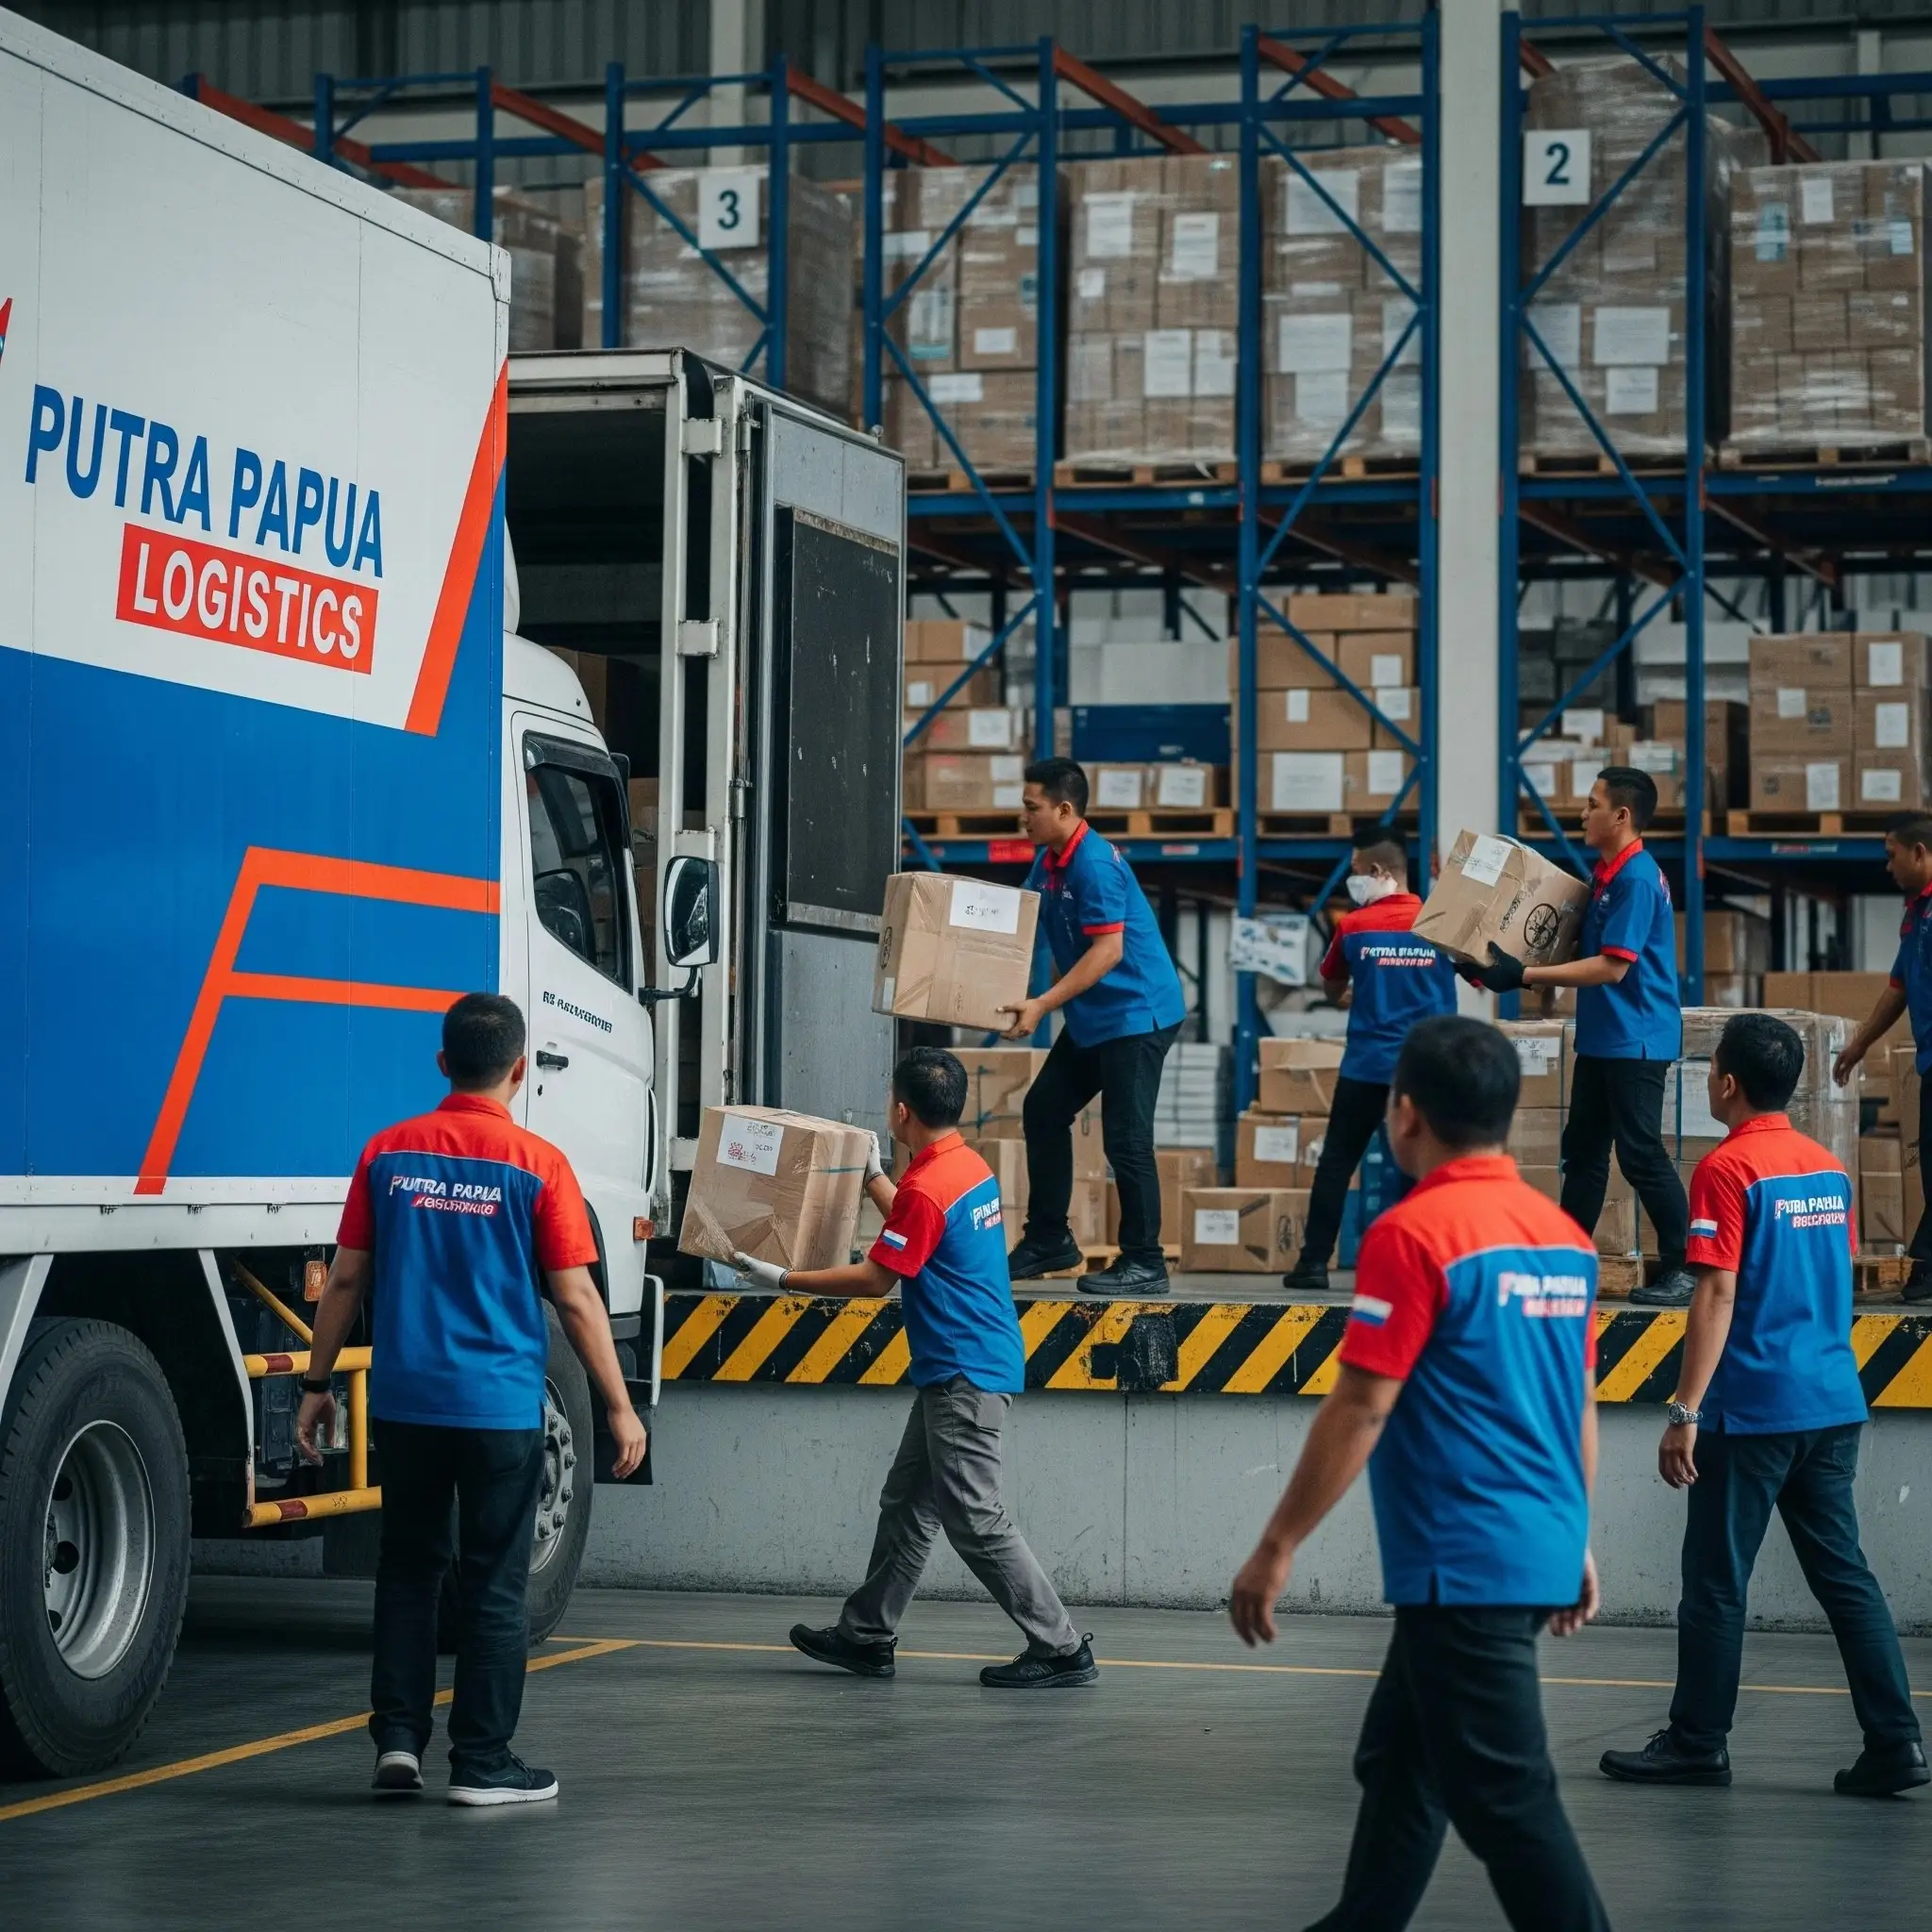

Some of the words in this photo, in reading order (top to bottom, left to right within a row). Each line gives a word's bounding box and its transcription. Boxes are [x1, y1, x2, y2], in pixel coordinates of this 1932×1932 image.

[1545, 142, 1570, 185] 2
[718, 190, 740, 230] 3
[25, 384, 211, 531] PUTRA
[229, 448, 383, 578] PAPUA
[133, 542, 363, 660] LOGISTICS
